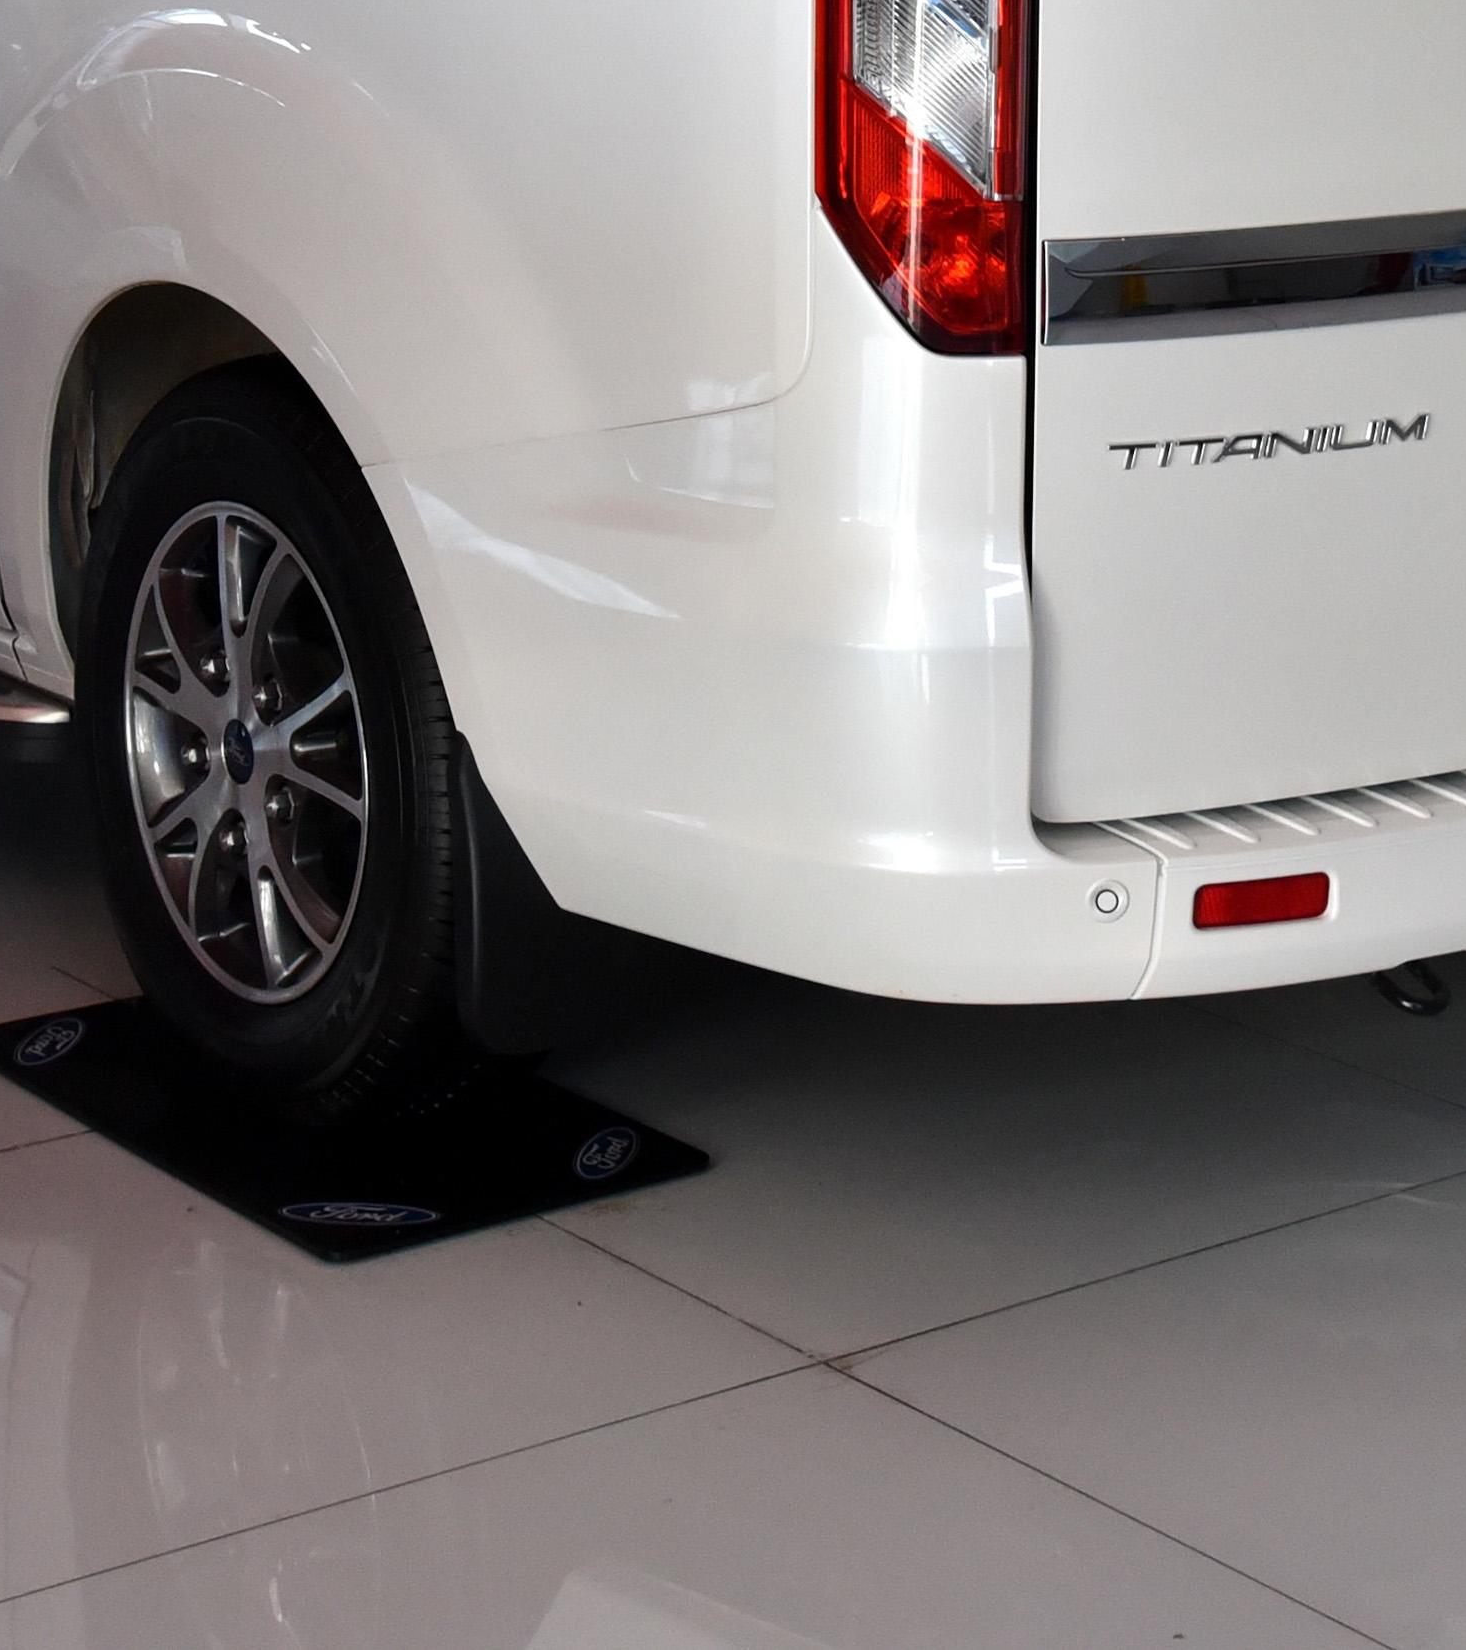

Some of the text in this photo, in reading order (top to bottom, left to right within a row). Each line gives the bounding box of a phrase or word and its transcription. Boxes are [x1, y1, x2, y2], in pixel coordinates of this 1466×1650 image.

[1108, 412, 1431, 471] TITANIUM
[24, 1025, 76, 1058] Ford
[582, 1135, 630, 1170] Ford
[309, 1204, 409, 1223] Ford
